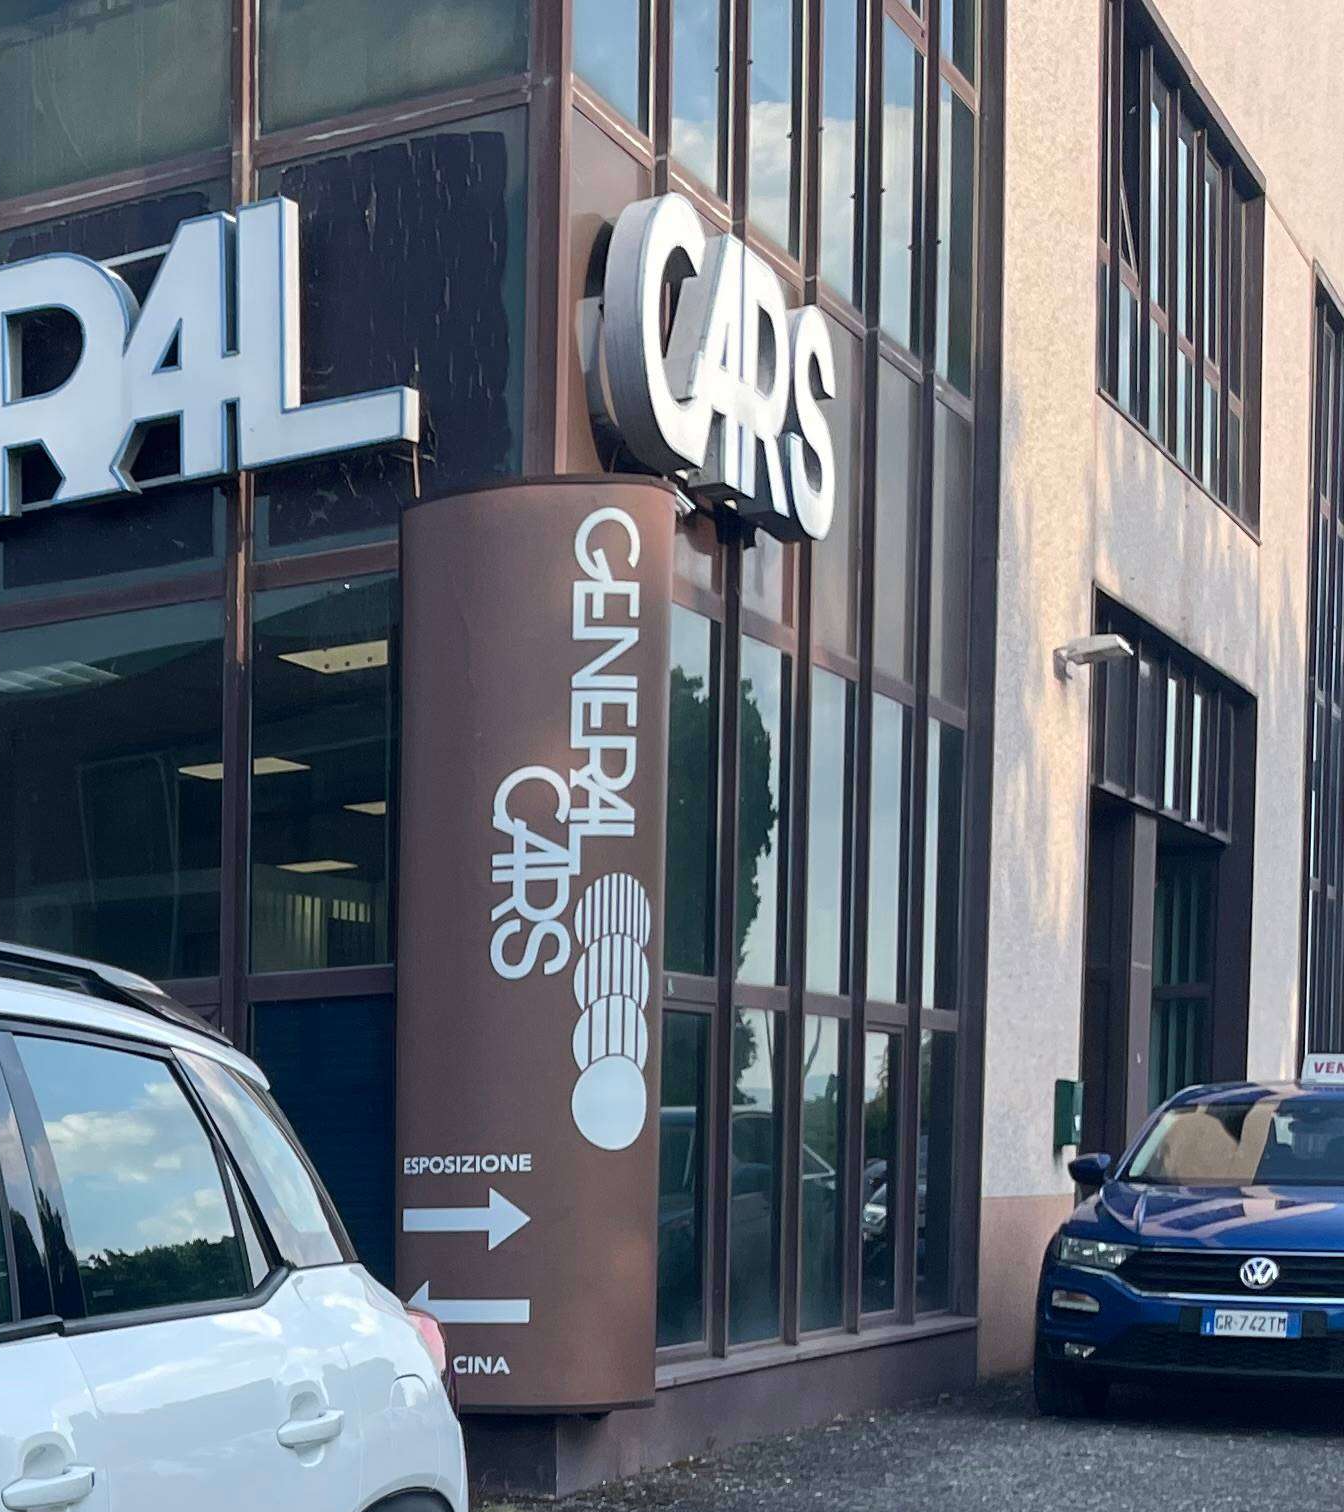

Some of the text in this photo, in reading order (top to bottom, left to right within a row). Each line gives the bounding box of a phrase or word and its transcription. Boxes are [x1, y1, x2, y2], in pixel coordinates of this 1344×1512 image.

[606, 192, 836, 541] CARS
[569, 506, 640, 876] GENERAL
[489, 765, 572, 981] CARS
[403, 1153, 532, 1175] ESPOSIZIONE
